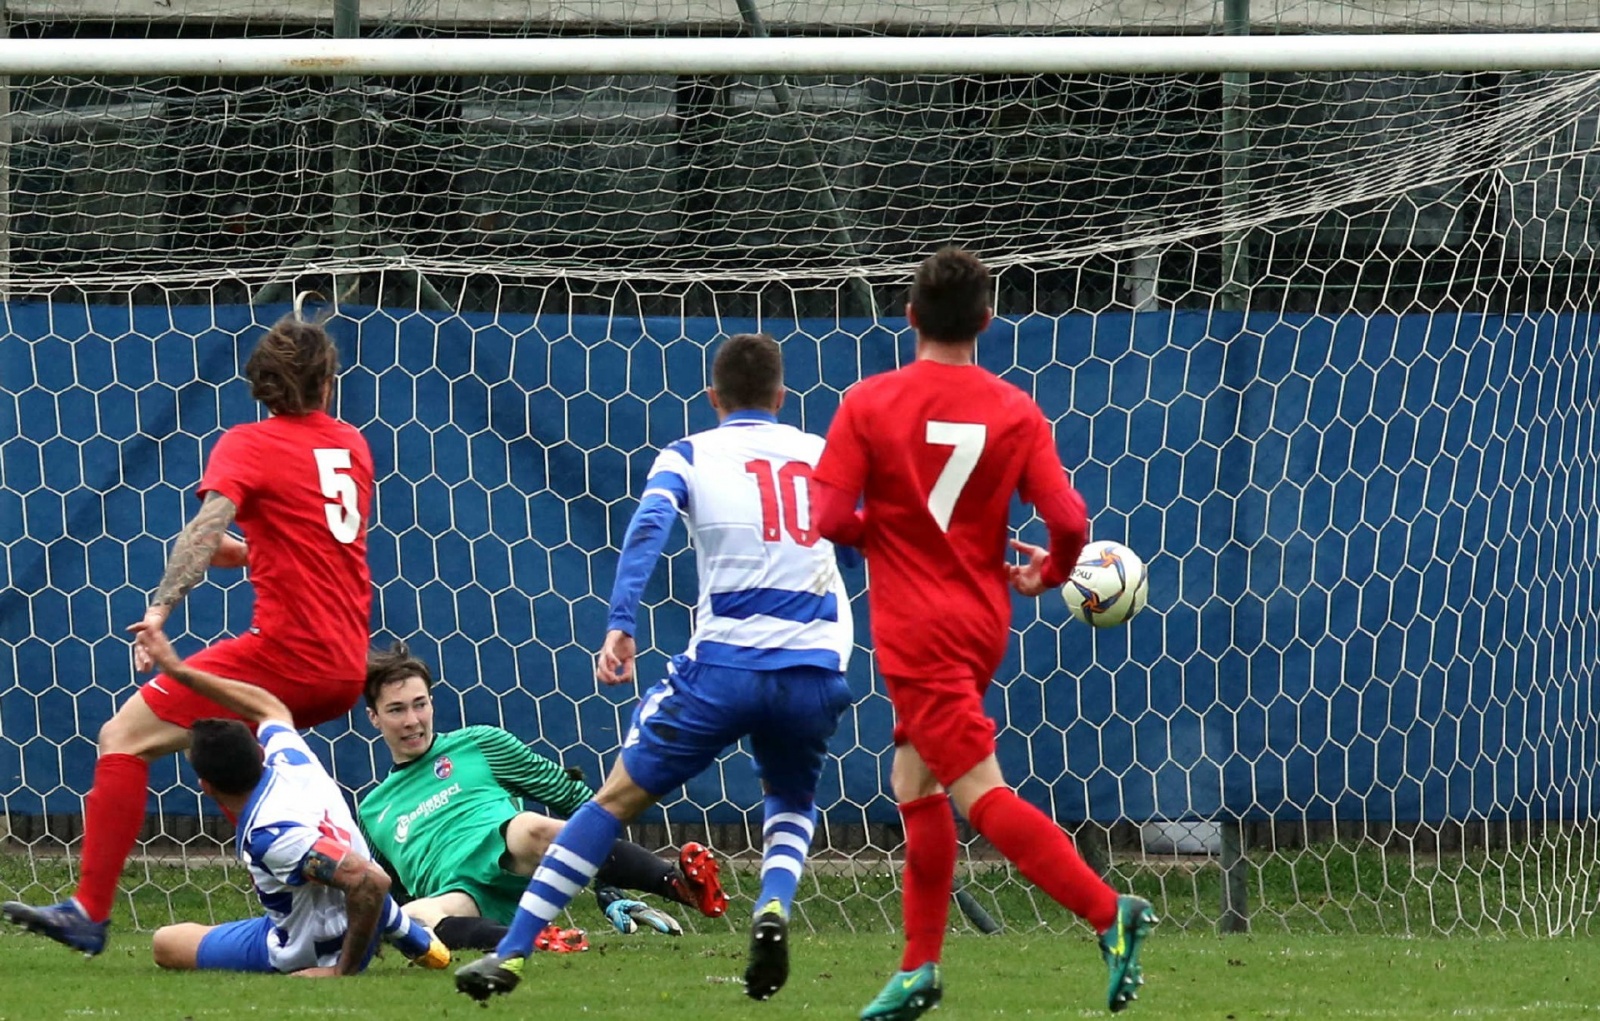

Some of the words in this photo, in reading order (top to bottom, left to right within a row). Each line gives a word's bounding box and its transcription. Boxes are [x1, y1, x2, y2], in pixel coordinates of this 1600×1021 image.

[313, 448, 361, 544] 5
[745, 459, 821, 548] 10
[926, 420, 987, 533] 7
